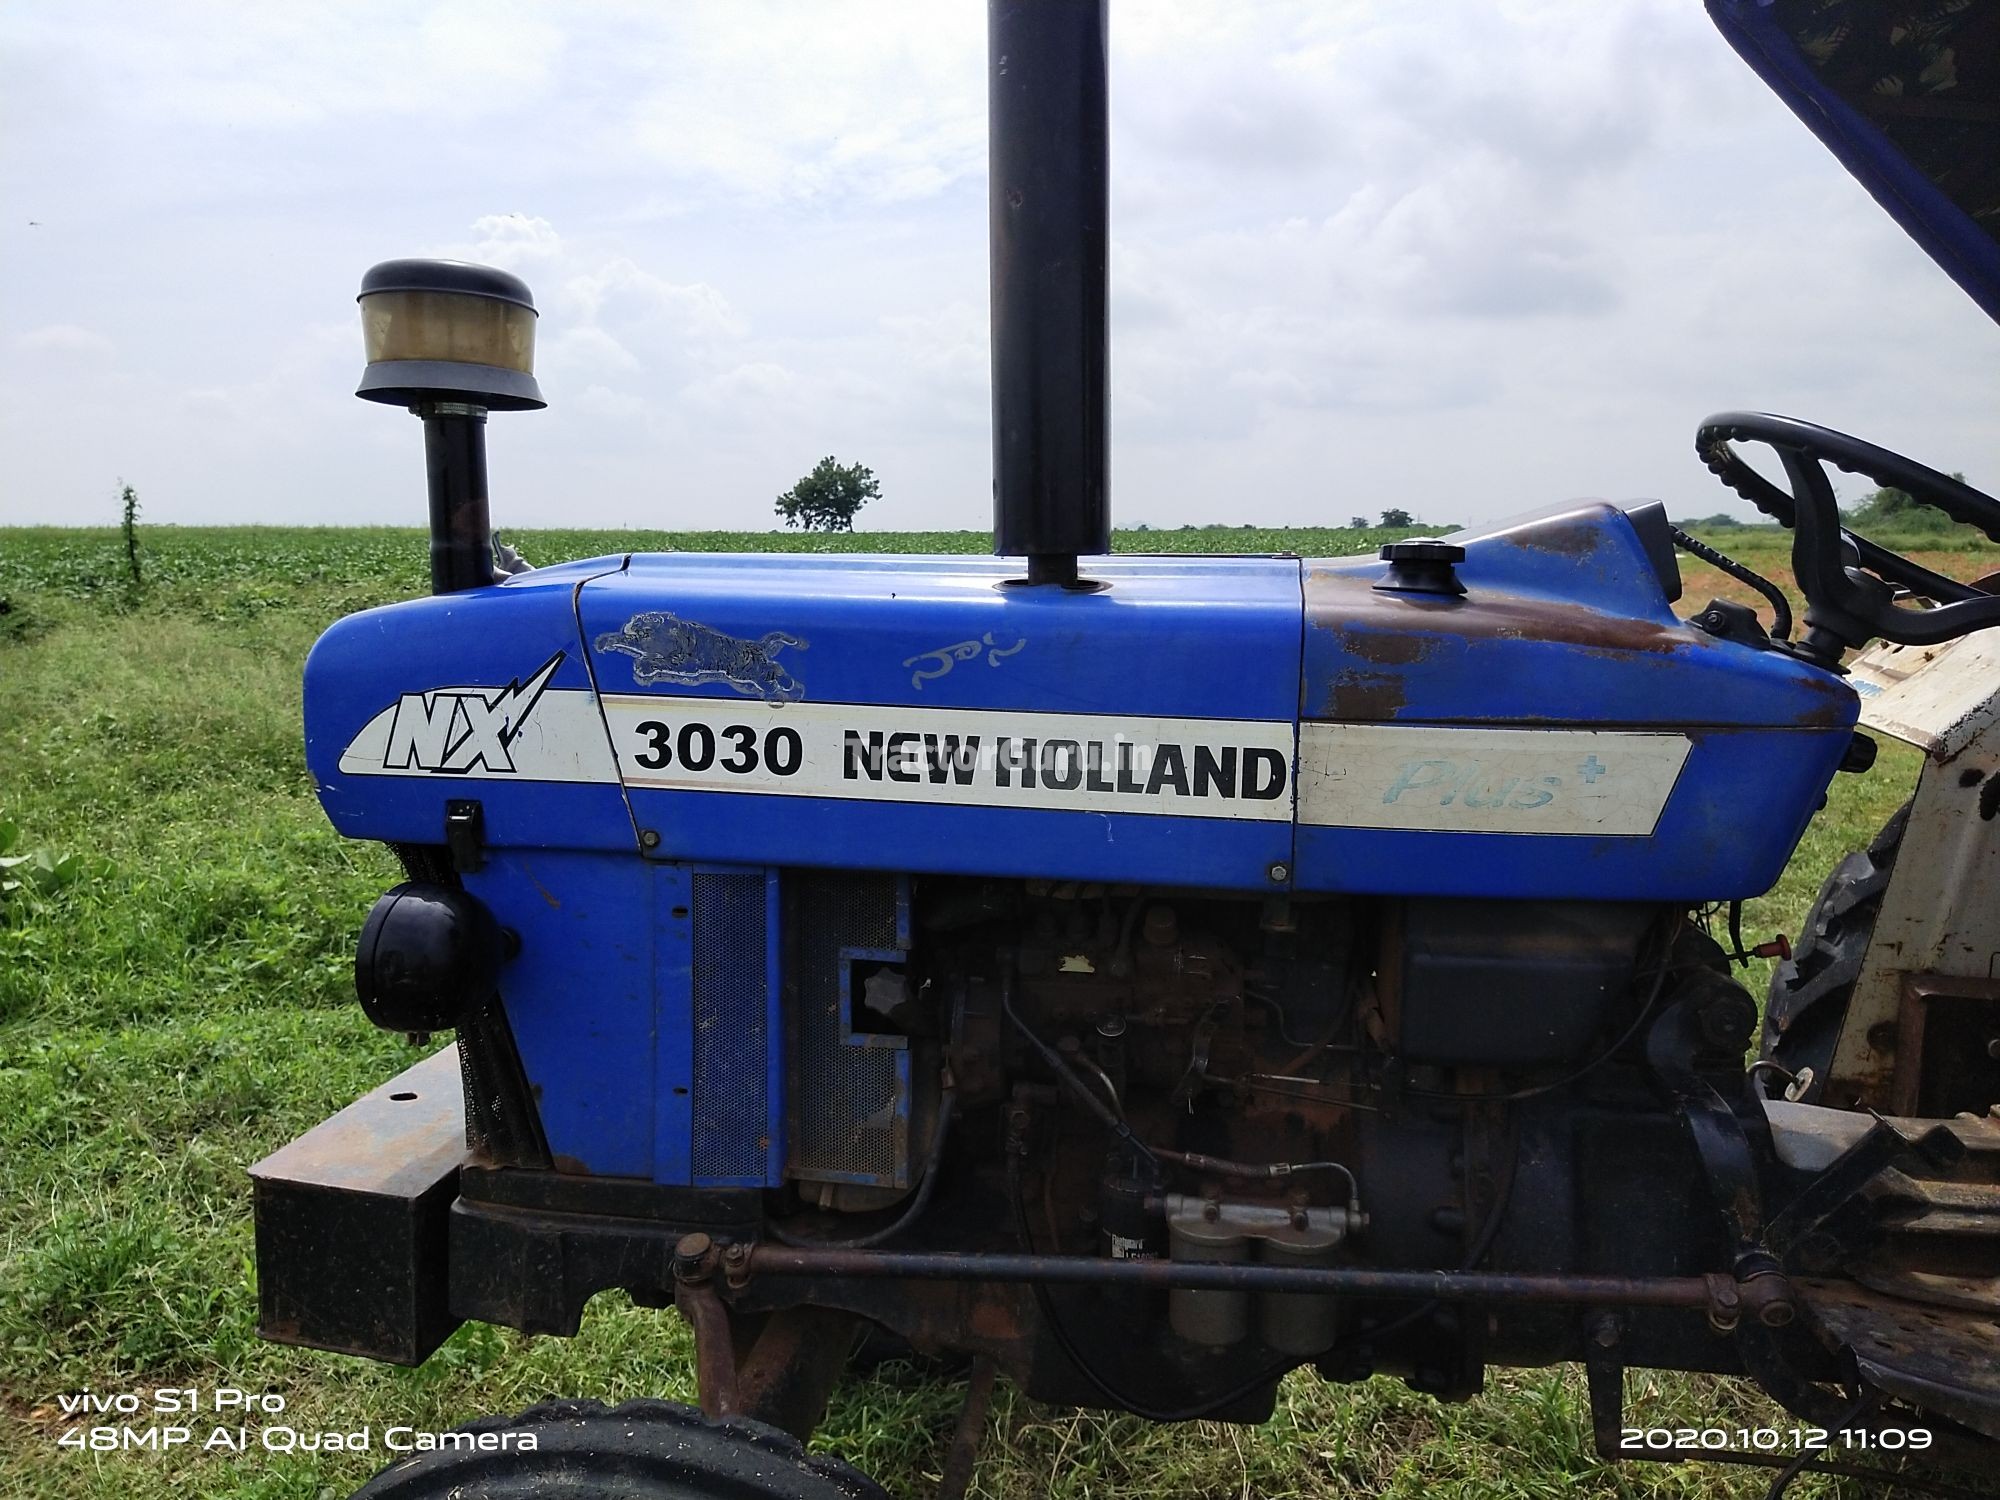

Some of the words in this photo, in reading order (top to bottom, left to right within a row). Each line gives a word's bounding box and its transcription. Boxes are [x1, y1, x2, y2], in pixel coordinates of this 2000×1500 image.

[382, 649, 567, 773] NX
[634, 720, 803, 776] 3030
[843, 729, 981, 786] NEW
[995, 737, 1288, 800] HOLLAND
